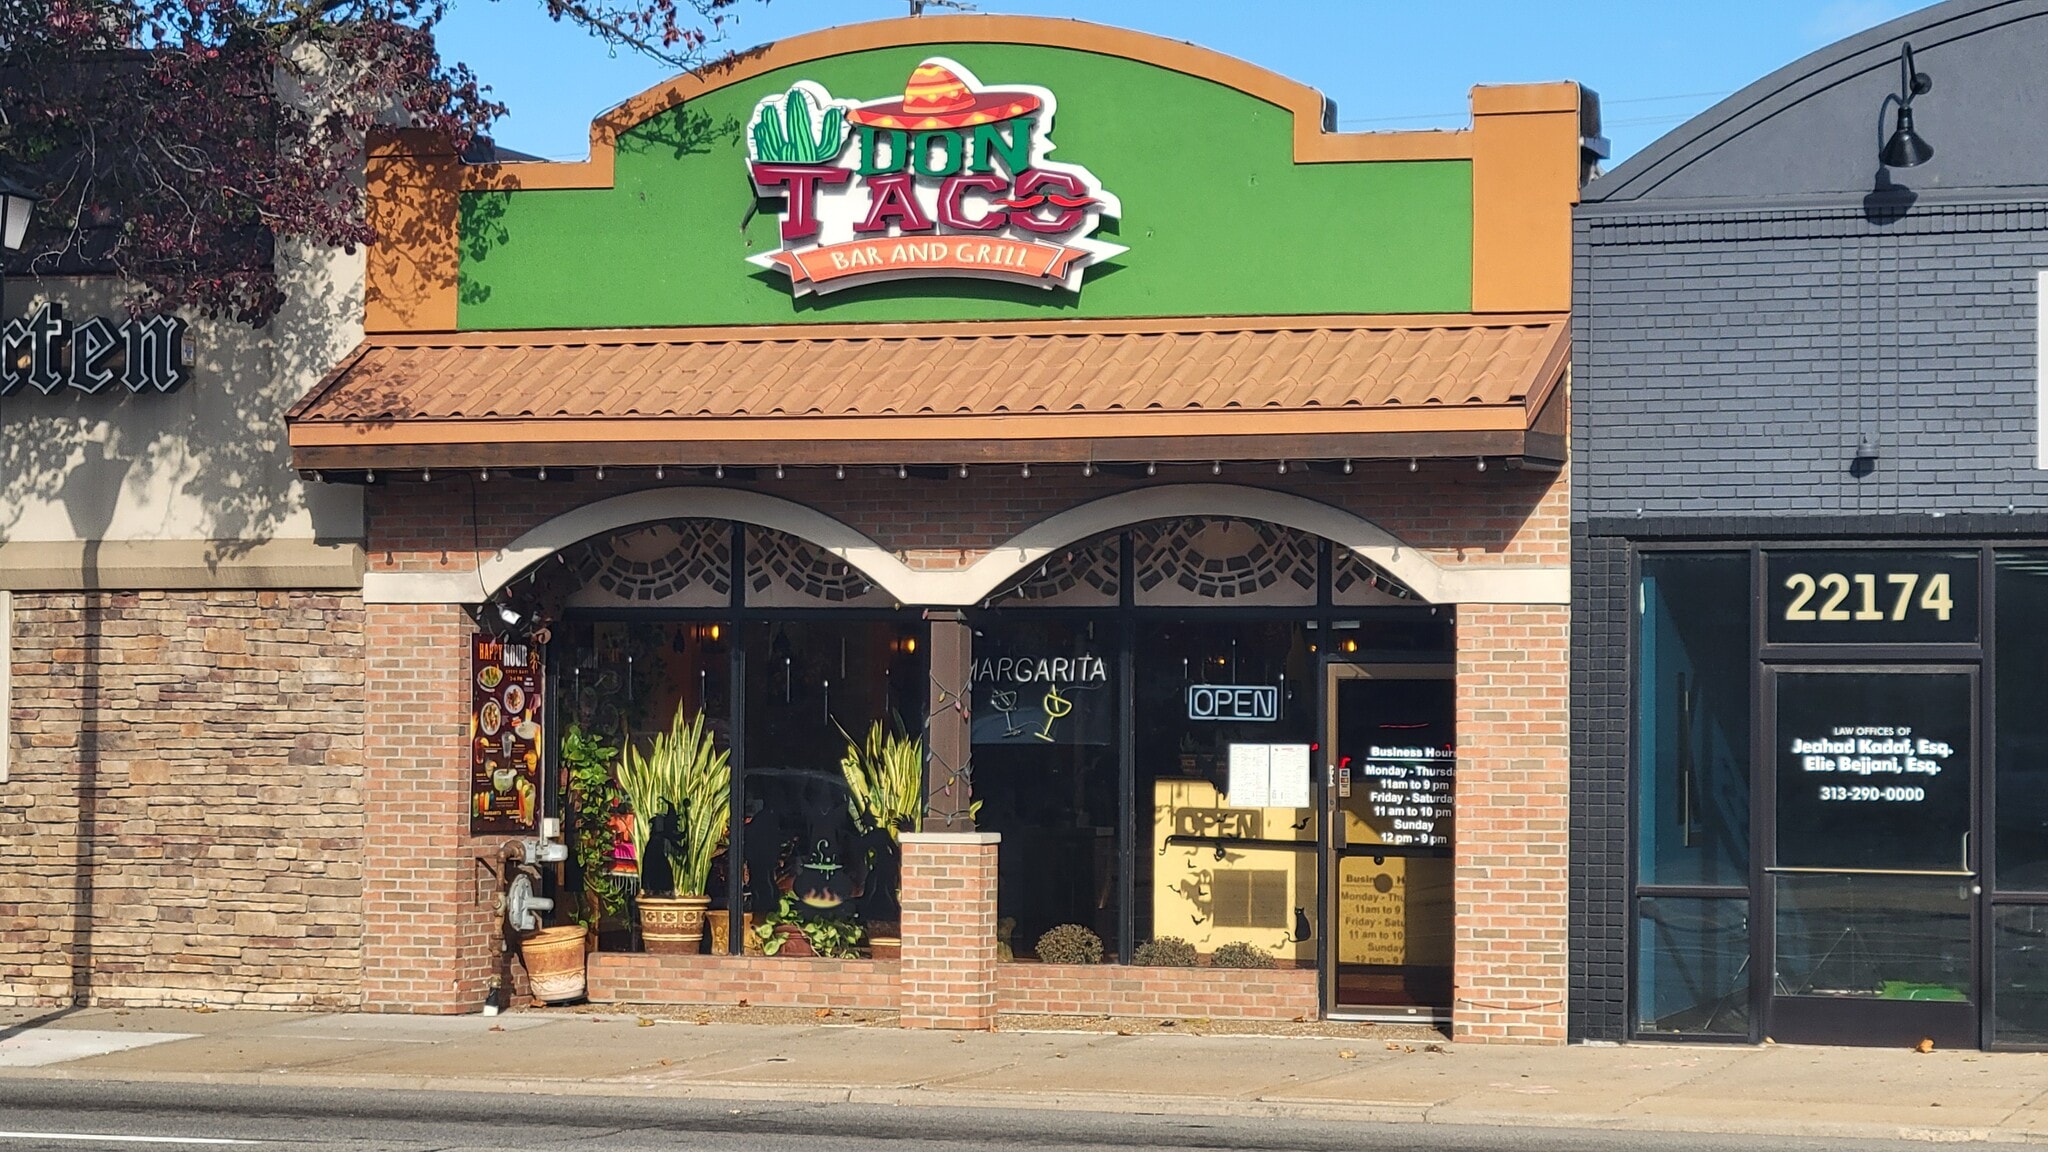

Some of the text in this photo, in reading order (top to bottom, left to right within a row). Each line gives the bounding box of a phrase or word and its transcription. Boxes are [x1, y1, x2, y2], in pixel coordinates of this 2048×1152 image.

[852, 118, 1034, 177] DON
[752, 163, 1090, 241] TACO
[831, 242, 1028, 271] BAR AND GRILL
[1785, 573, 1953, 621] 22174
[479, 643, 528, 667] HAPPY HOUR
[1194, 689, 1272, 717] OPEN
[1834, 727, 1912, 736] LAW OFFICES OF
[1371, 746, 1422, 757] Business
[1792, 738, 1855, 754] Jeahad
[1917, 738, 1954, 758] Esq.
[1365, 765, 1407, 778] Monday
[1415, 766, 1456, 776] Thursda
[1804, 756, 1942, 775] Elie Bejjani, Esq.
[1381, 780, 1449, 791] 11am to 9 pm
[1370, 792, 1403, 804] Friday
[1820, 786, 1926, 802] 313-290-0000
[1374, 806, 1451, 818] 11 am to 10 pm
[1394, 819, 1434, 831] Sunday
[1381, 833, 1393, 842] 12
[1395, 834, 1413, 844] pm
[1421, 833, 1428, 843] 9
[1430, 835, 1447, 845] pm
[1341, 892, 1379, 903] Monday
[1382, 905, 1392, 914] to
[1395, 905, 1401, 914] 9
[1345, 917, 1375, 928] Friday
[1349, 930, 1359, 939] 11
[1380, 931, 1389, 939] to
[1393, 931, 1404, 939] 10
[1367, 942, 1405, 954] Sunday
